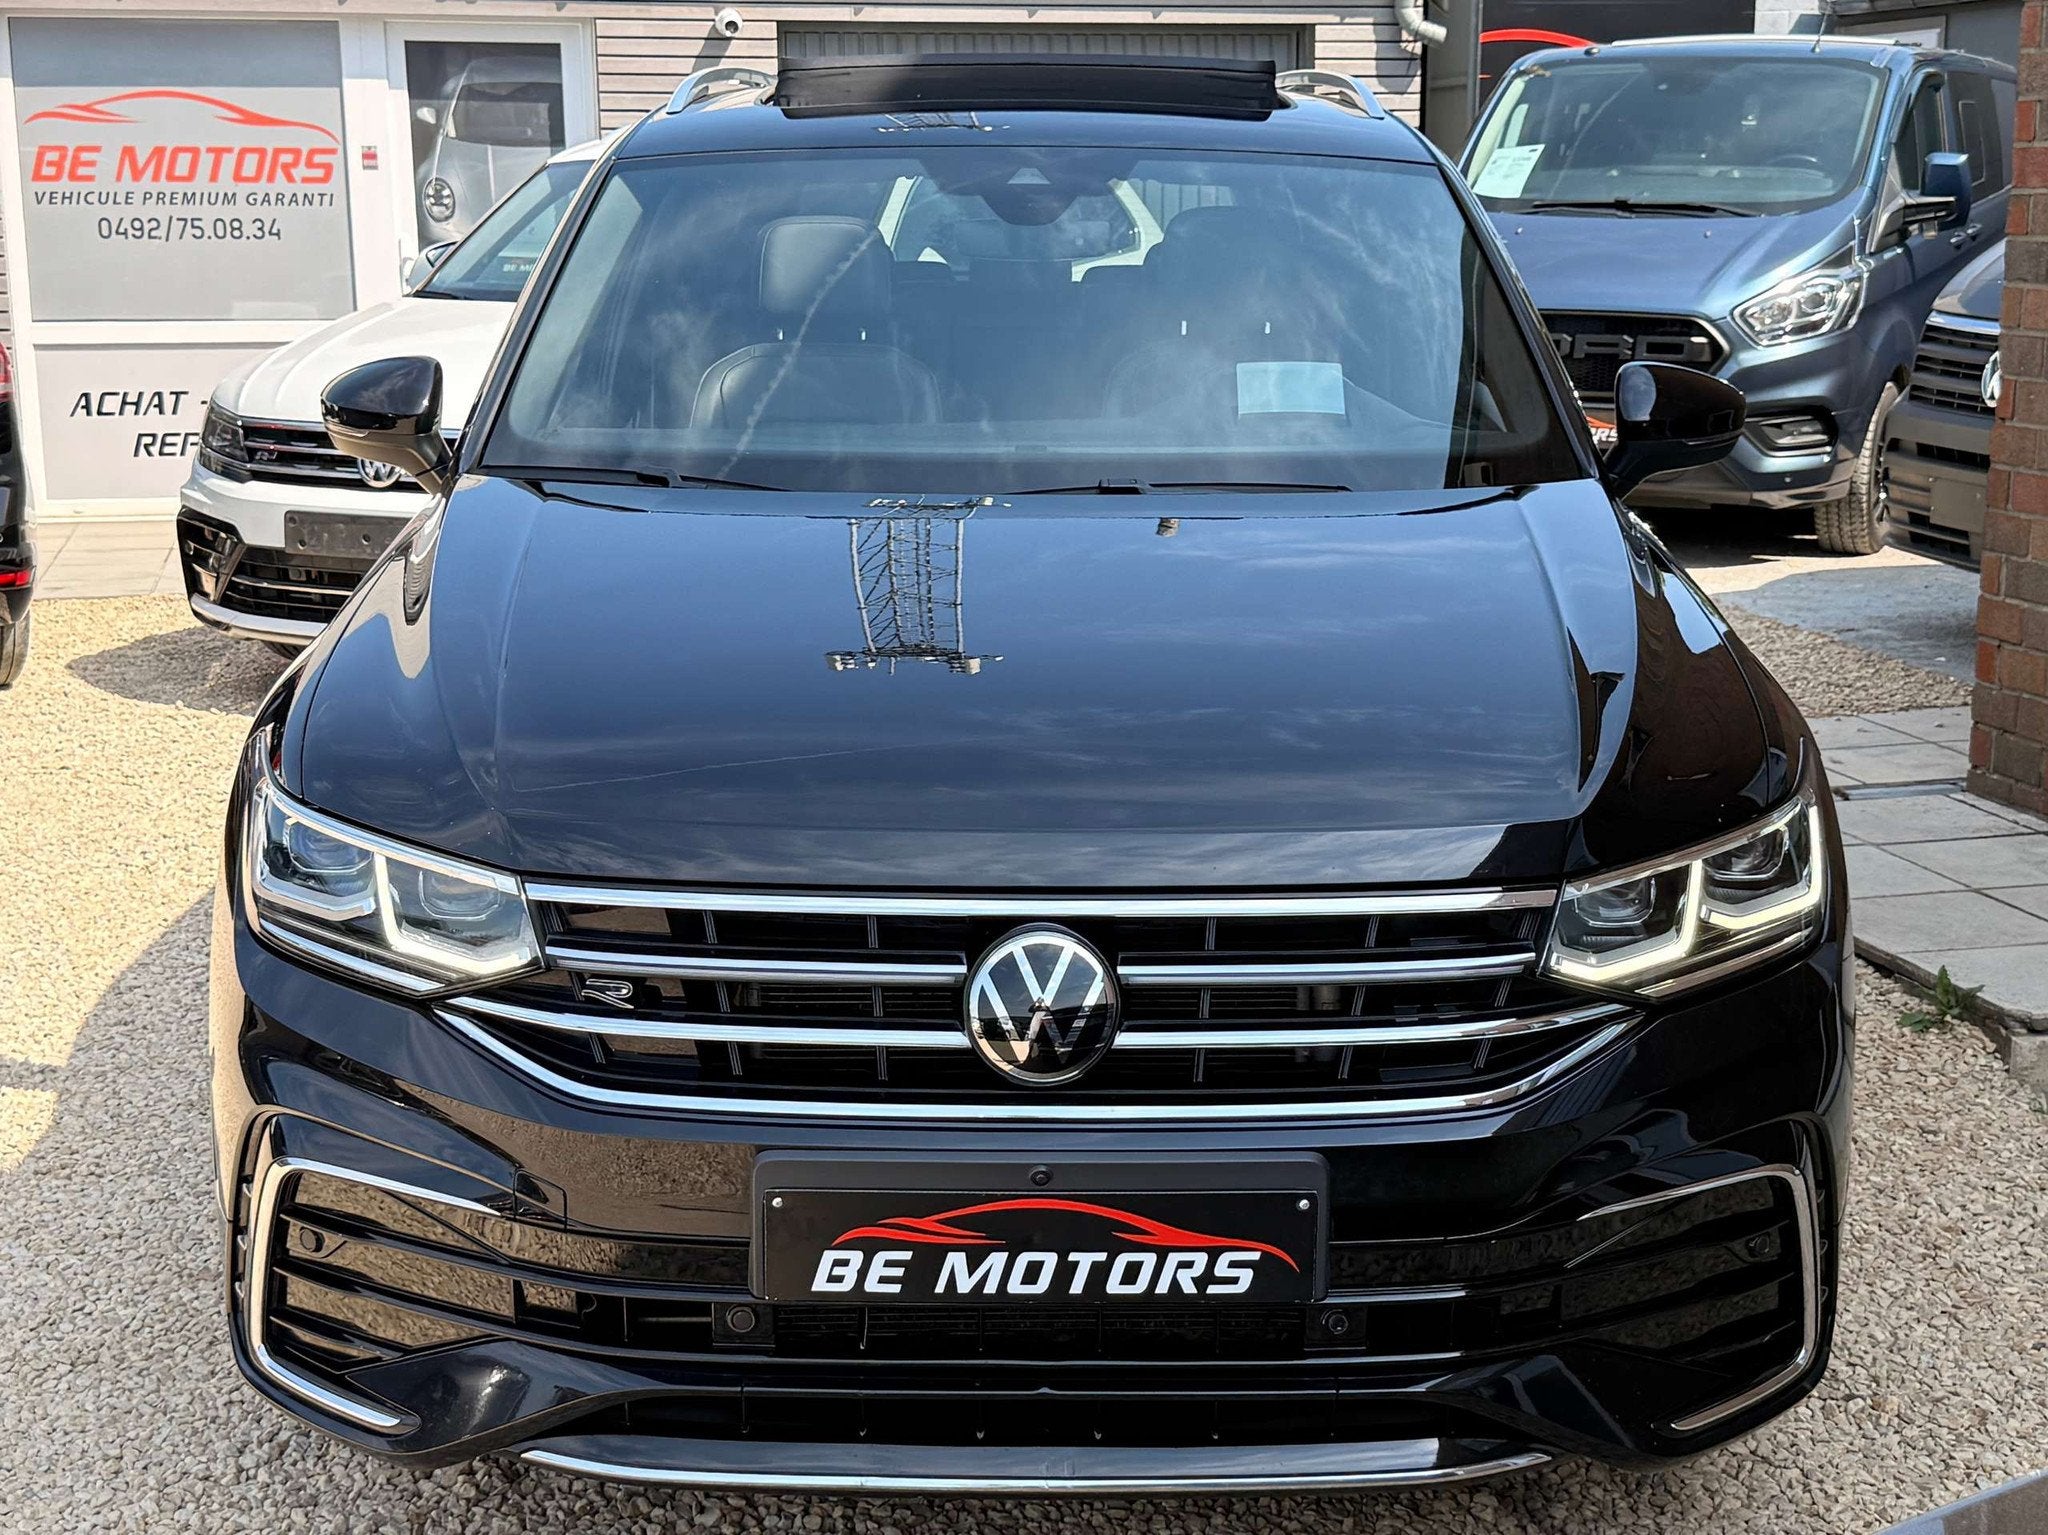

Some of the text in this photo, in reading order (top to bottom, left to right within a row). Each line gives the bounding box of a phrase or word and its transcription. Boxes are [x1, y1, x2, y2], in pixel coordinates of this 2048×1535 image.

[31, 145, 102, 183] BE
[115, 145, 340, 184] MOTORS
[34, 191, 335, 207] VEHICULE PREMIUM GARANTI
[98, 215, 282, 242] 0492/75.08.34
[69, 391, 190, 418] ACHAT
[811, 1249, 1262, 1295] BE MOTORS
